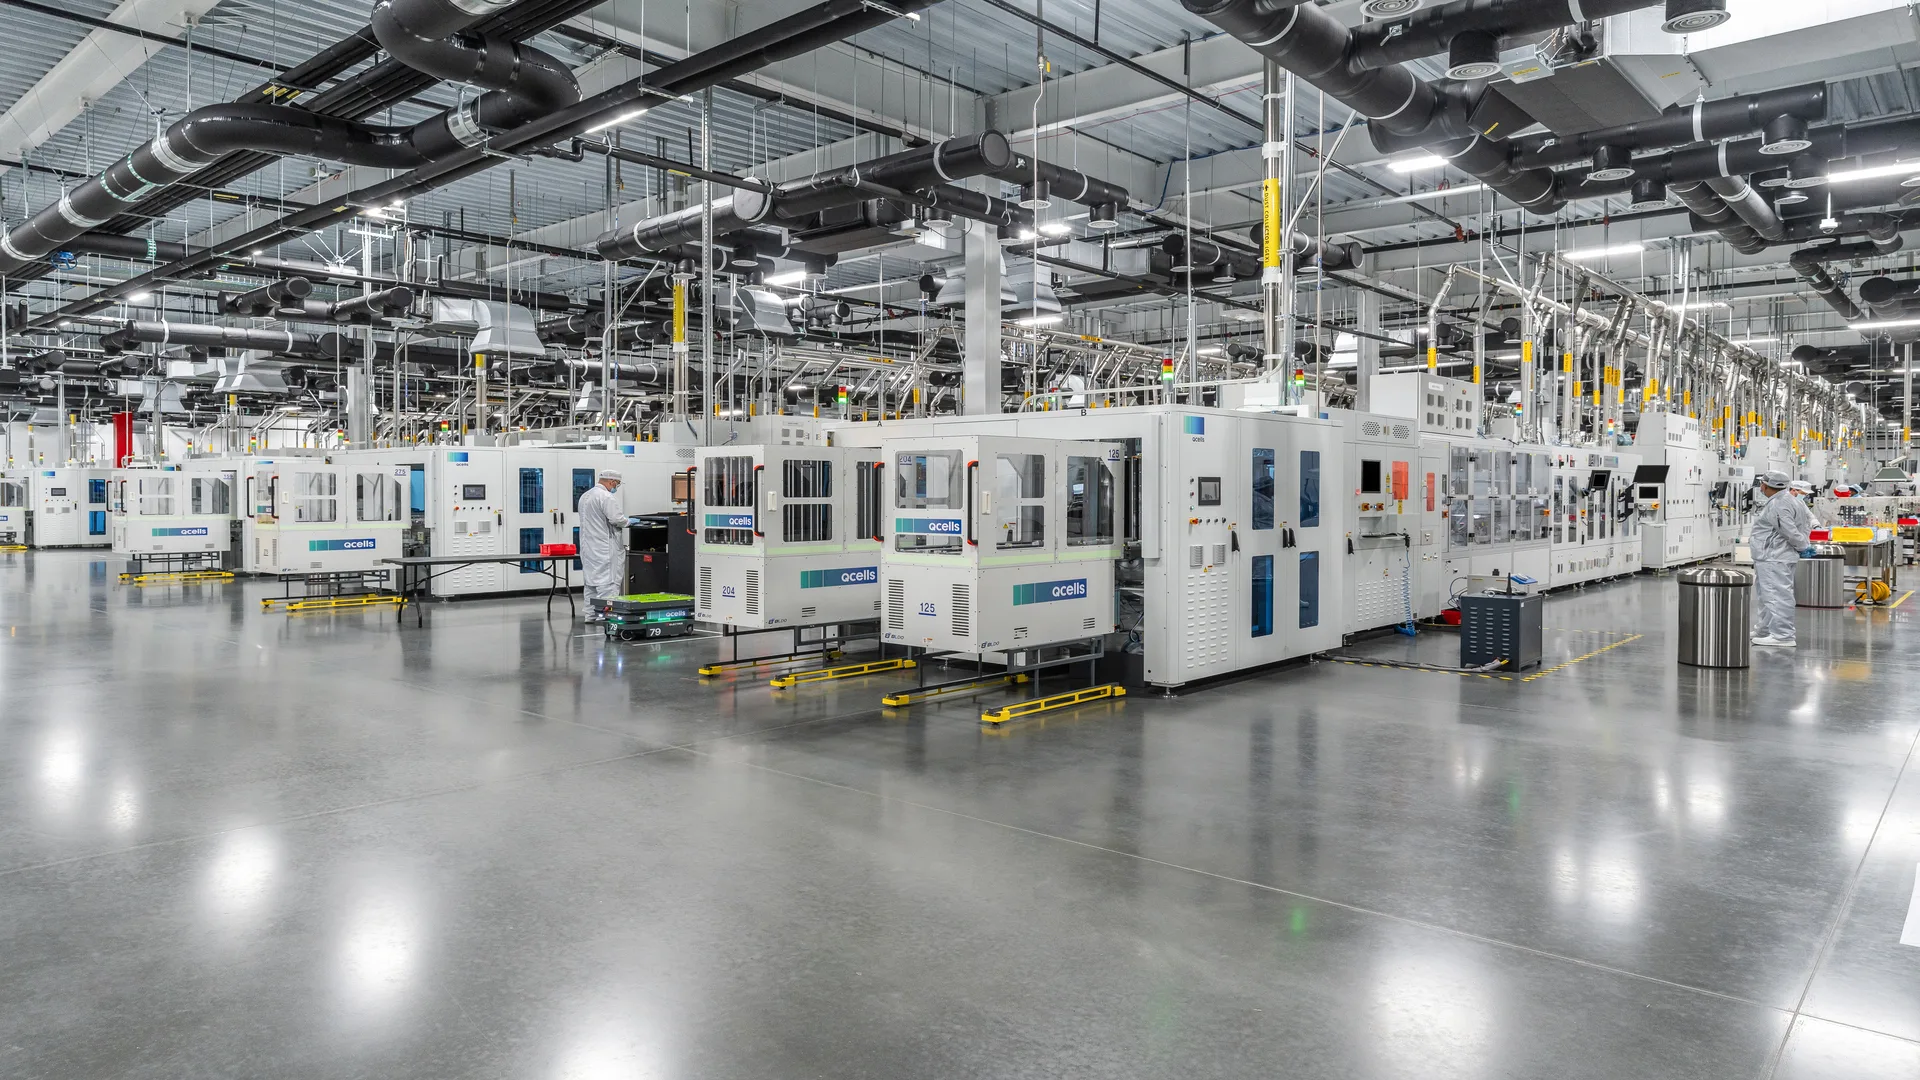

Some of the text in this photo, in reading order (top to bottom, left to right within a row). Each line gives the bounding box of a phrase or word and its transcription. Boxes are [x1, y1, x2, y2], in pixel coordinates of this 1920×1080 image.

[1108, 449, 1120, 458] 125
[722, 585, 735, 595] 204
[920, 602, 935, 613] 125
[610, 623, 618, 631] 79
[649, 628, 661, 636] 79
